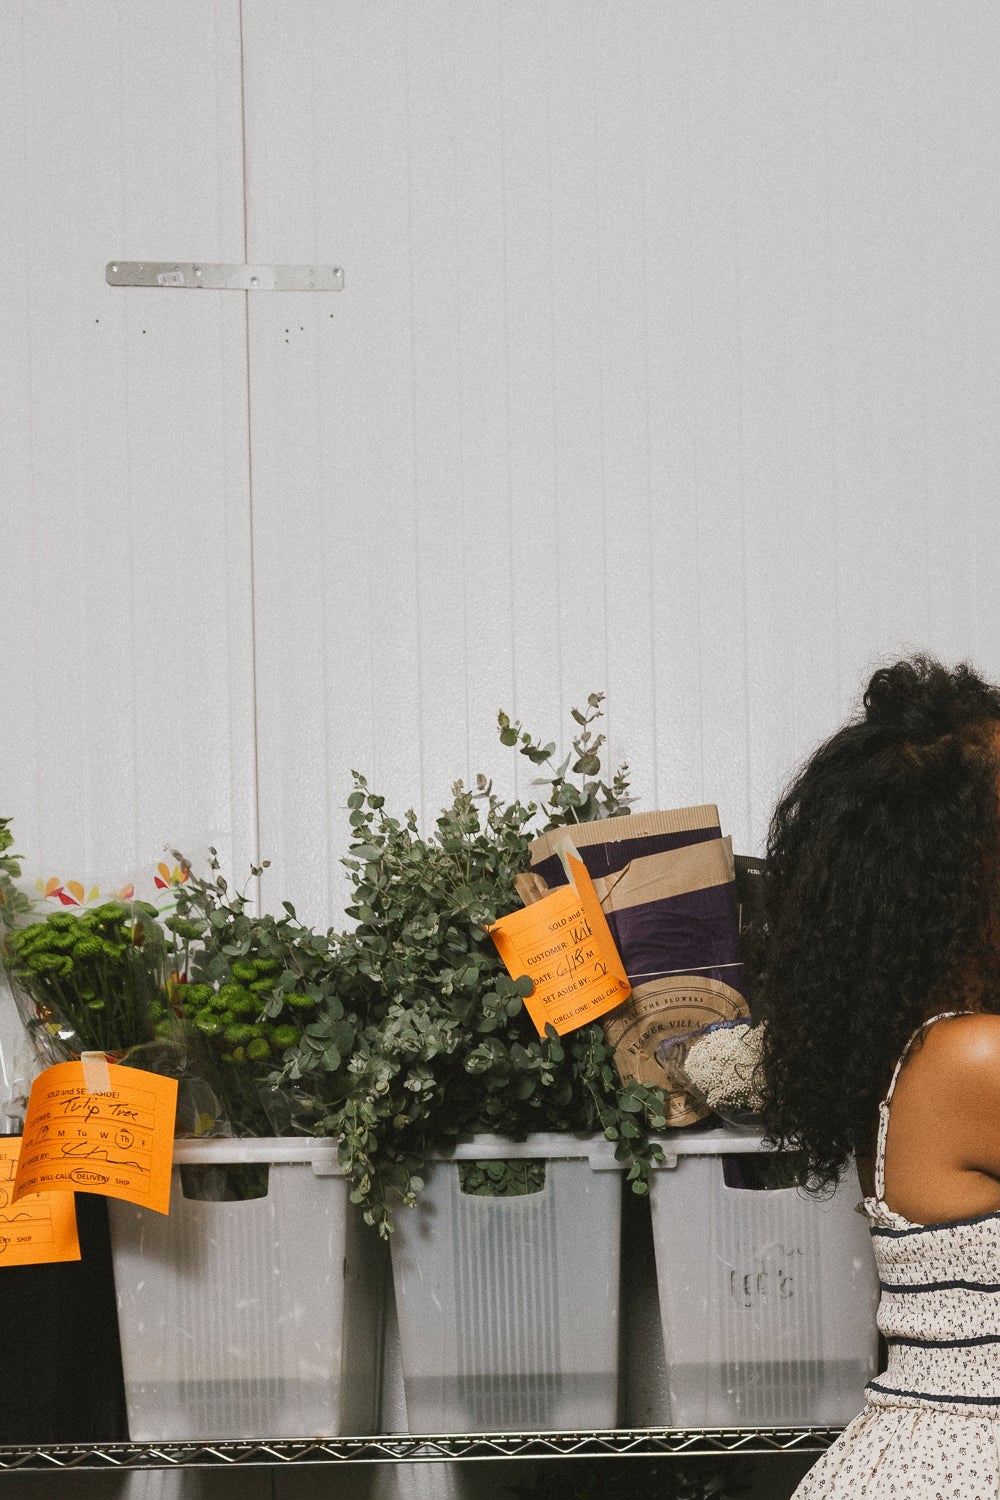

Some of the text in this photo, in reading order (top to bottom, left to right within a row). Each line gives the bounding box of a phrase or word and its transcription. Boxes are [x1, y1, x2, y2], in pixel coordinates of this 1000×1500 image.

[548, 910, 581, 933] SOLD and
[527, 941, 570, 966] CUSTOMER:
[533, 950, 595, 987] DATE: M
[543, 976, 591, 1005] SET ASIDE BY:
[553, 986, 619, 1026] CIRCLE ONE: WILL-CALL
[644, 996, 704, 1011] THE FLOWERS
[629, 1024, 664, 1055] FLOWER
[47, 1089, 60, 1100] SOLD
[61, 1088, 74, 1097] and
[60, 1096, 100, 1122] Tulip
[108, 1103, 140, 1121] Tree
[77, 1129, 87, 1137] Tu
[100, 1131, 109, 1139] W
[120, 1135, 130, 1144] Th
[40, 1173, 72, 1182] WILL-CALL
[76, 1173, 110, 1183] DELIVERY
[115, 1178, 130, 1186] SHIP
